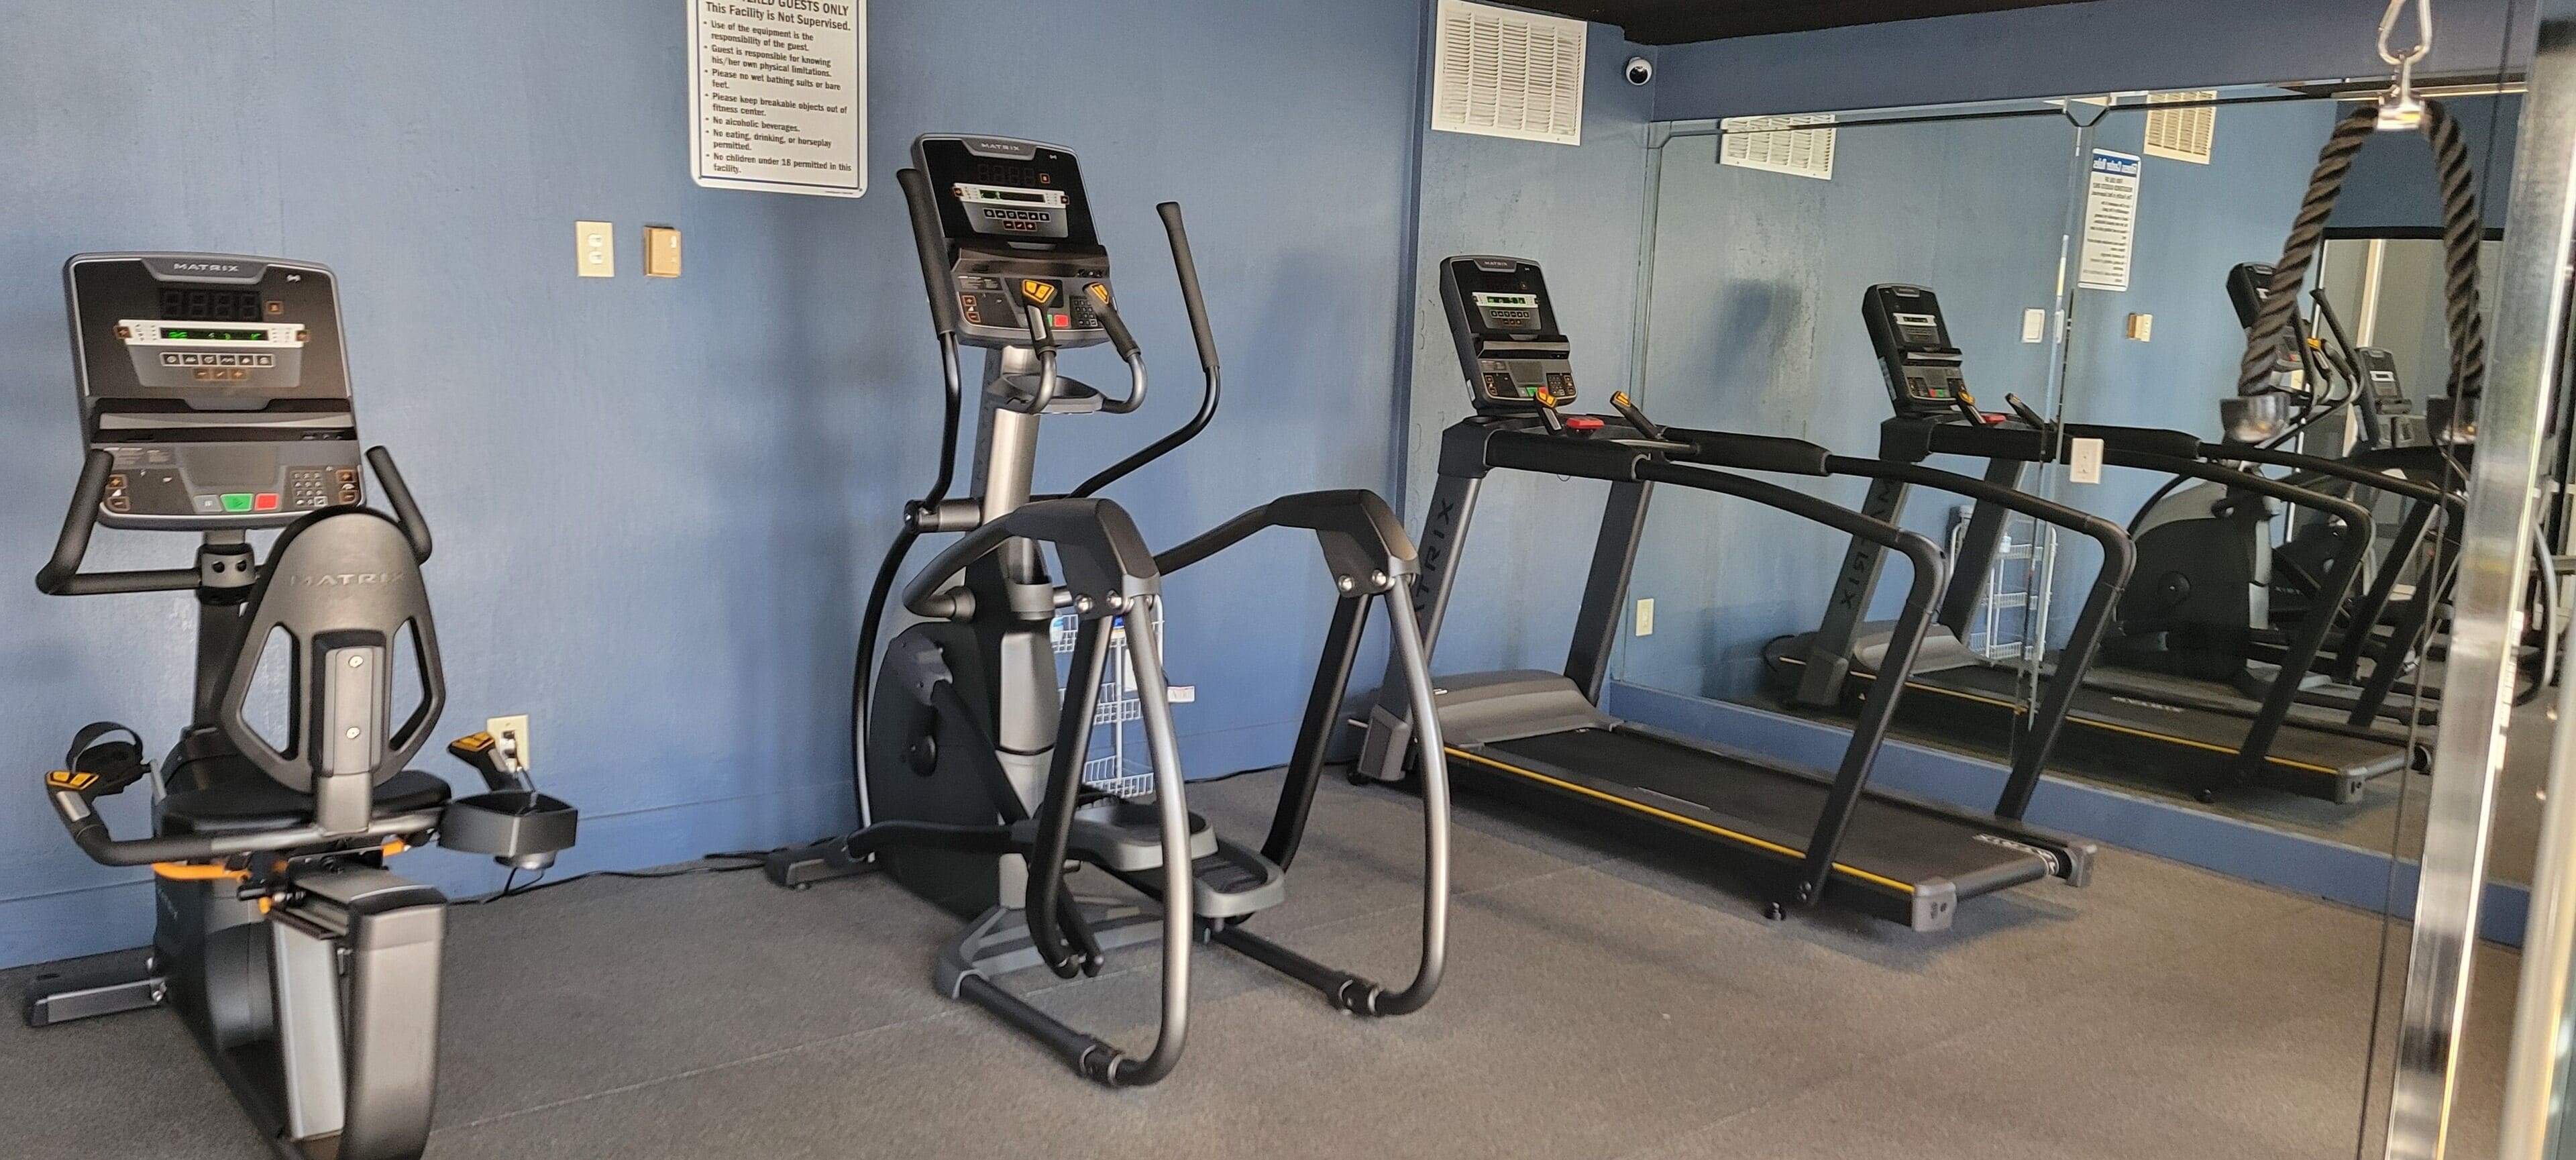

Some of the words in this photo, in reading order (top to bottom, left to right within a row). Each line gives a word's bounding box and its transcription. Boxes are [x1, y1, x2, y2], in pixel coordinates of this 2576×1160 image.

[706, 1, 726, 13] This
[729, 5, 764, 21] Facility
[767, 9, 775, 20] is
[778, 11, 794, 23] Not
[797, 14, 851, 31] Supervised.
[778, 0, 820, 12] GUESTS
[823, 3, 849, 16] ONLY
[711, 20, 725, 29] Use
[738, 24, 750, 32] the
[752, 28, 791, 38] equipment
[794, 31, 800, 39] is
[802, 32, 814, 41] the
[711, 34, 761, 46] responsibility
[773, 40, 785, 48] the
[711, 44, 734, 54] Guest
[736, 47, 742, 55] is
[745, 50, 787, 61] responsible
[790, 54, 800, 62] for
[802, 56, 831, 68] knowing
[712, 56, 740, 66] his/her
[759, 62, 790, 72] physical
[792, 65, 833, 77] limitations.
[712, 68, 737, 78] Please
[767, 75, 794, 87] bathing
[796, 79, 813, 87] suits
[825, 81, 841, 91] bare
[712, 79, 730, 89] feet.
[712, 92, 738, 102] Please
[740, 95, 758, 105] keep
[760, 97, 796, 108] breakable
[798, 102, 824, 111] objects
[840, 106, 847, 114] of
[712, 103, 738, 113] fitness
[741, 107, 766, 116] center.
[713, 116, 723, 124] No
[725, 118, 759, 127] alcoholic
[761, 121, 800, 132] beverages.
[713, 129, 723, 137] No
[798, 137, 832, 148] horseplay
[713, 142, 752, 151] permitted.
[981, 143, 1020, 151] MATRIX
[713, 163, 741, 174] facility.
[714, 152, 724, 160] No
[726, 154, 756, 163] children
[759, 157, 780, 165] under
[794, 160, 828, 169] permitted
[830, 162, 837, 170] in
[839, 163, 851, 171] this
[174, 263, 239, 272] MATRIX
